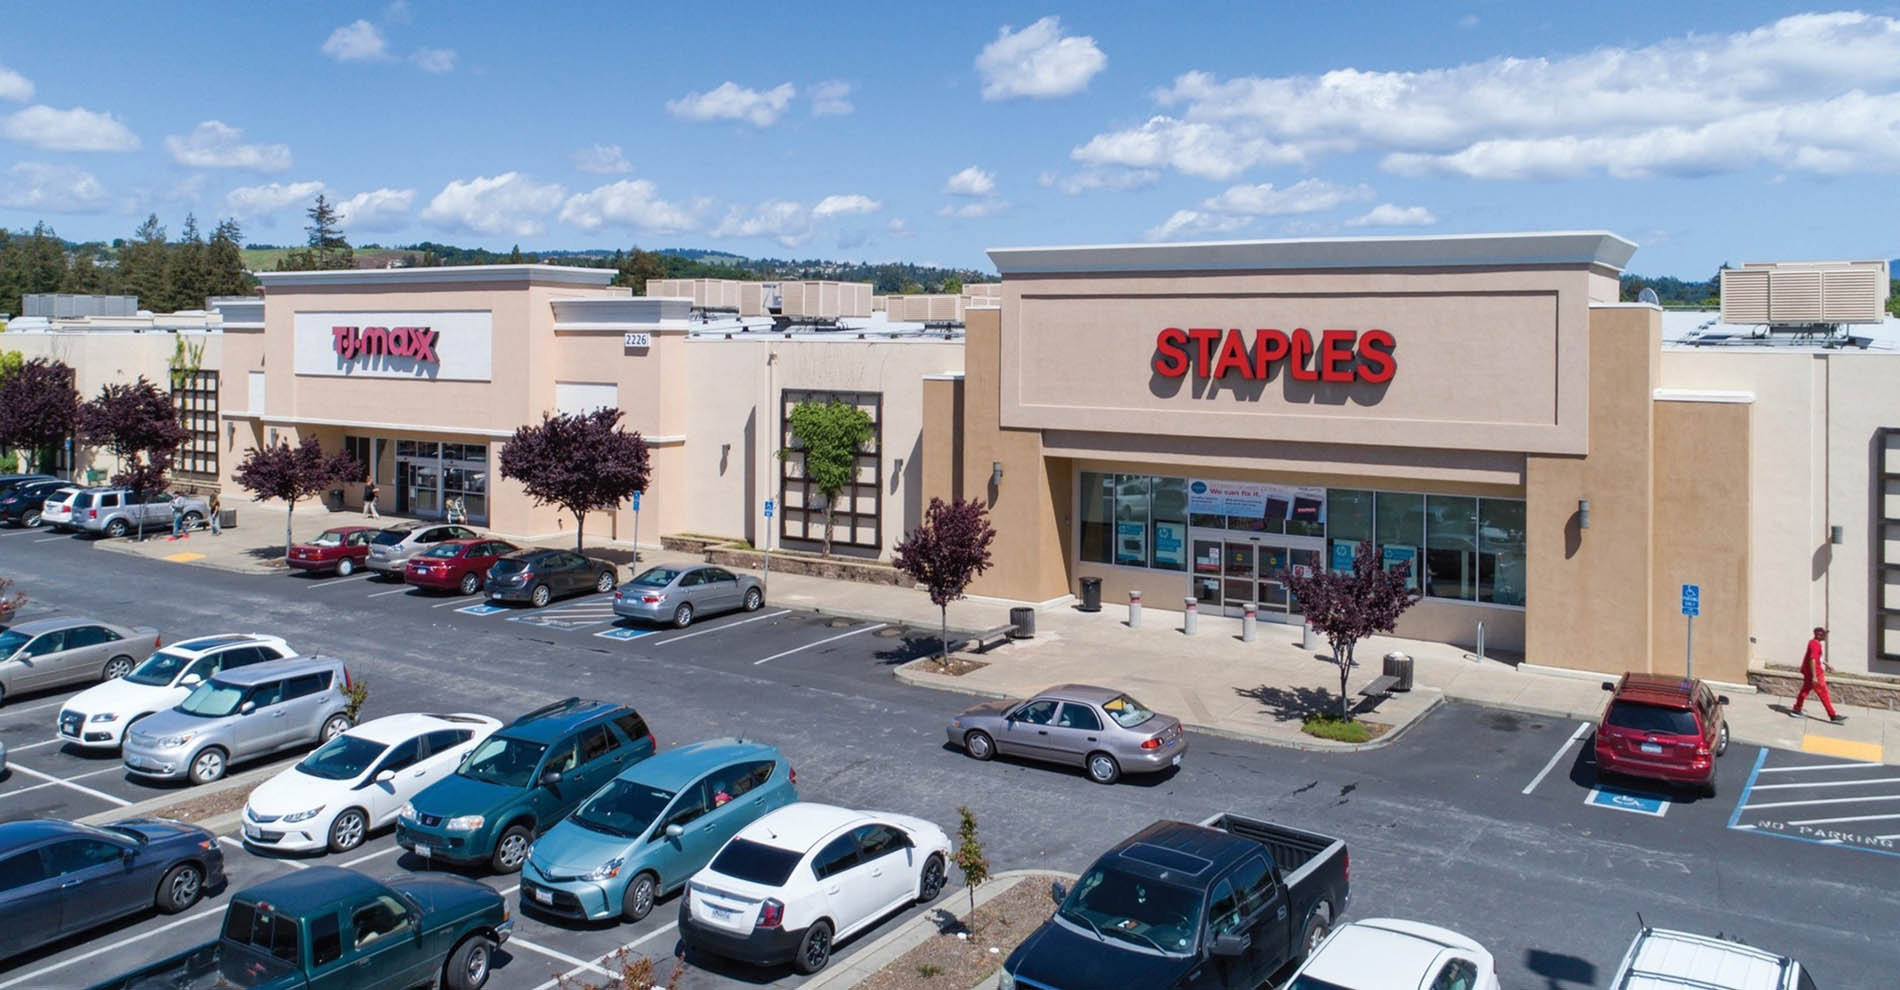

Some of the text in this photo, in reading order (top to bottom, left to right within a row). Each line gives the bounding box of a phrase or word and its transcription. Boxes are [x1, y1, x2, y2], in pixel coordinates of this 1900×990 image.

[626, 334, 647, 345] 2226
[1155, 327, 1397, 384] STAPLES
[1758, 819, 1894, 848] NO PARKING
